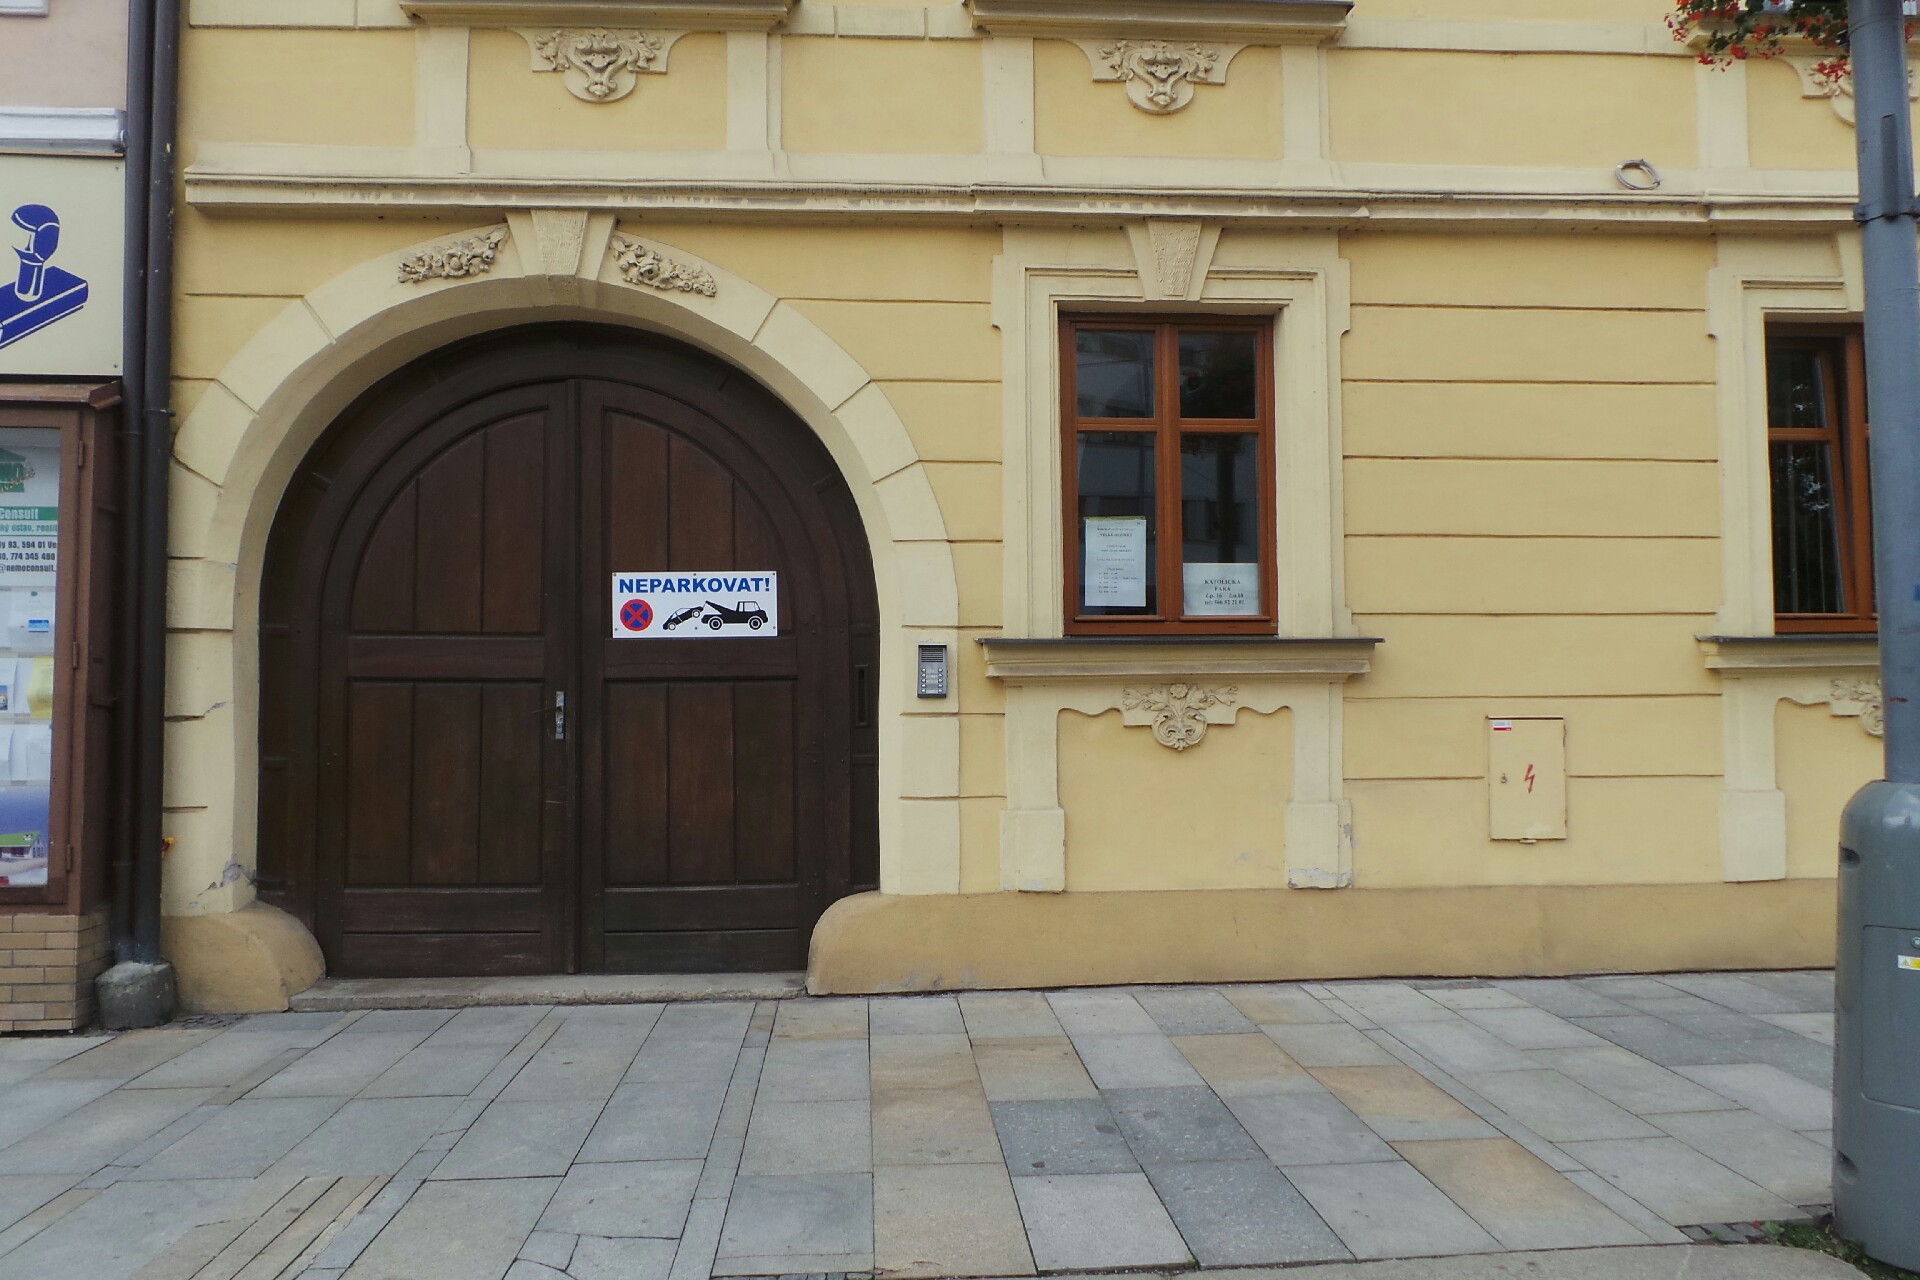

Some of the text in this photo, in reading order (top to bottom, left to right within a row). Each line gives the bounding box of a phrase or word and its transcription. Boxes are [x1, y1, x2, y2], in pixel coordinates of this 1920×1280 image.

[10, 552, 23, 560] 774
[25, 552, 39, 560] 345
[619, 577, 770, 594] NEPARKOVAT!
